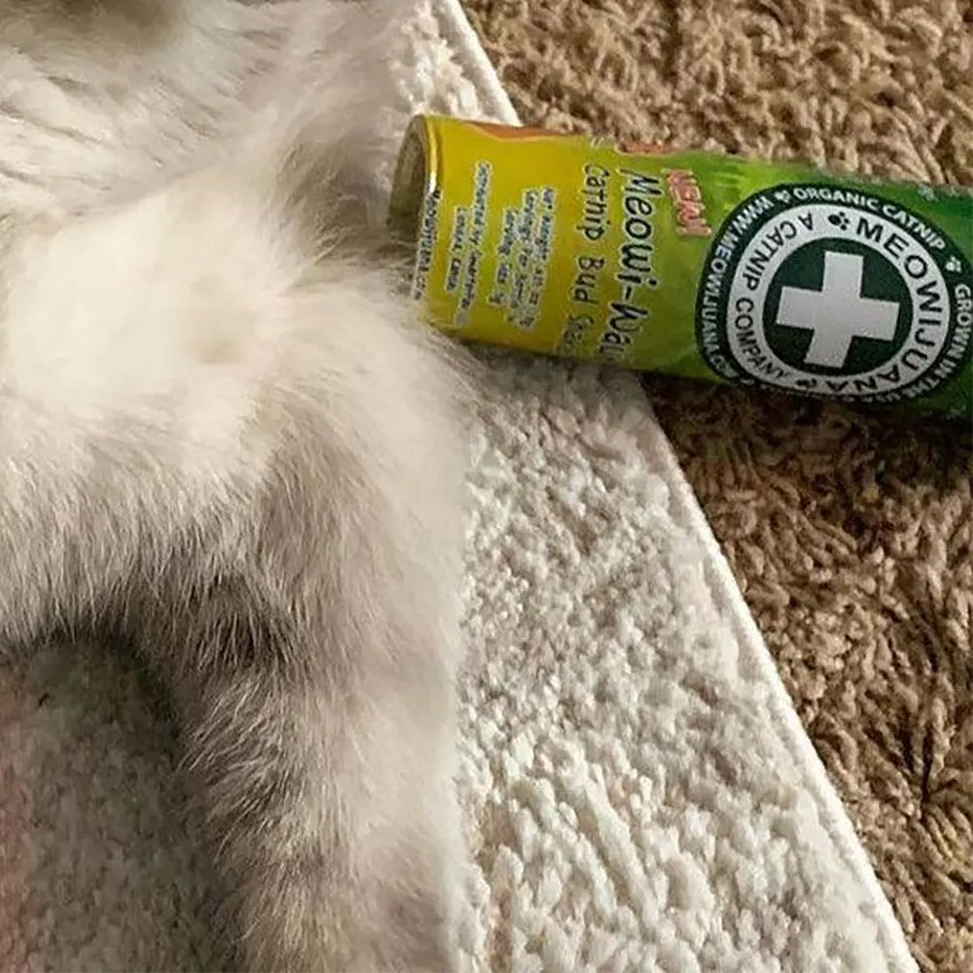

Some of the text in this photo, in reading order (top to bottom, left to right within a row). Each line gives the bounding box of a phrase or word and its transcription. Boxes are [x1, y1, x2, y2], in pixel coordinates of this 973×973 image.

[576, 164, 611, 242] Catnip
[794, 187, 947, 251] ORGANIC CATNIP
[572, 255, 606, 305] Bud
[734, 212, 815, 379] A CATNIP COMPANY
[827, 217, 943, 393] MEOWIJUANA
[947, 283, 973, 360] GROWN
